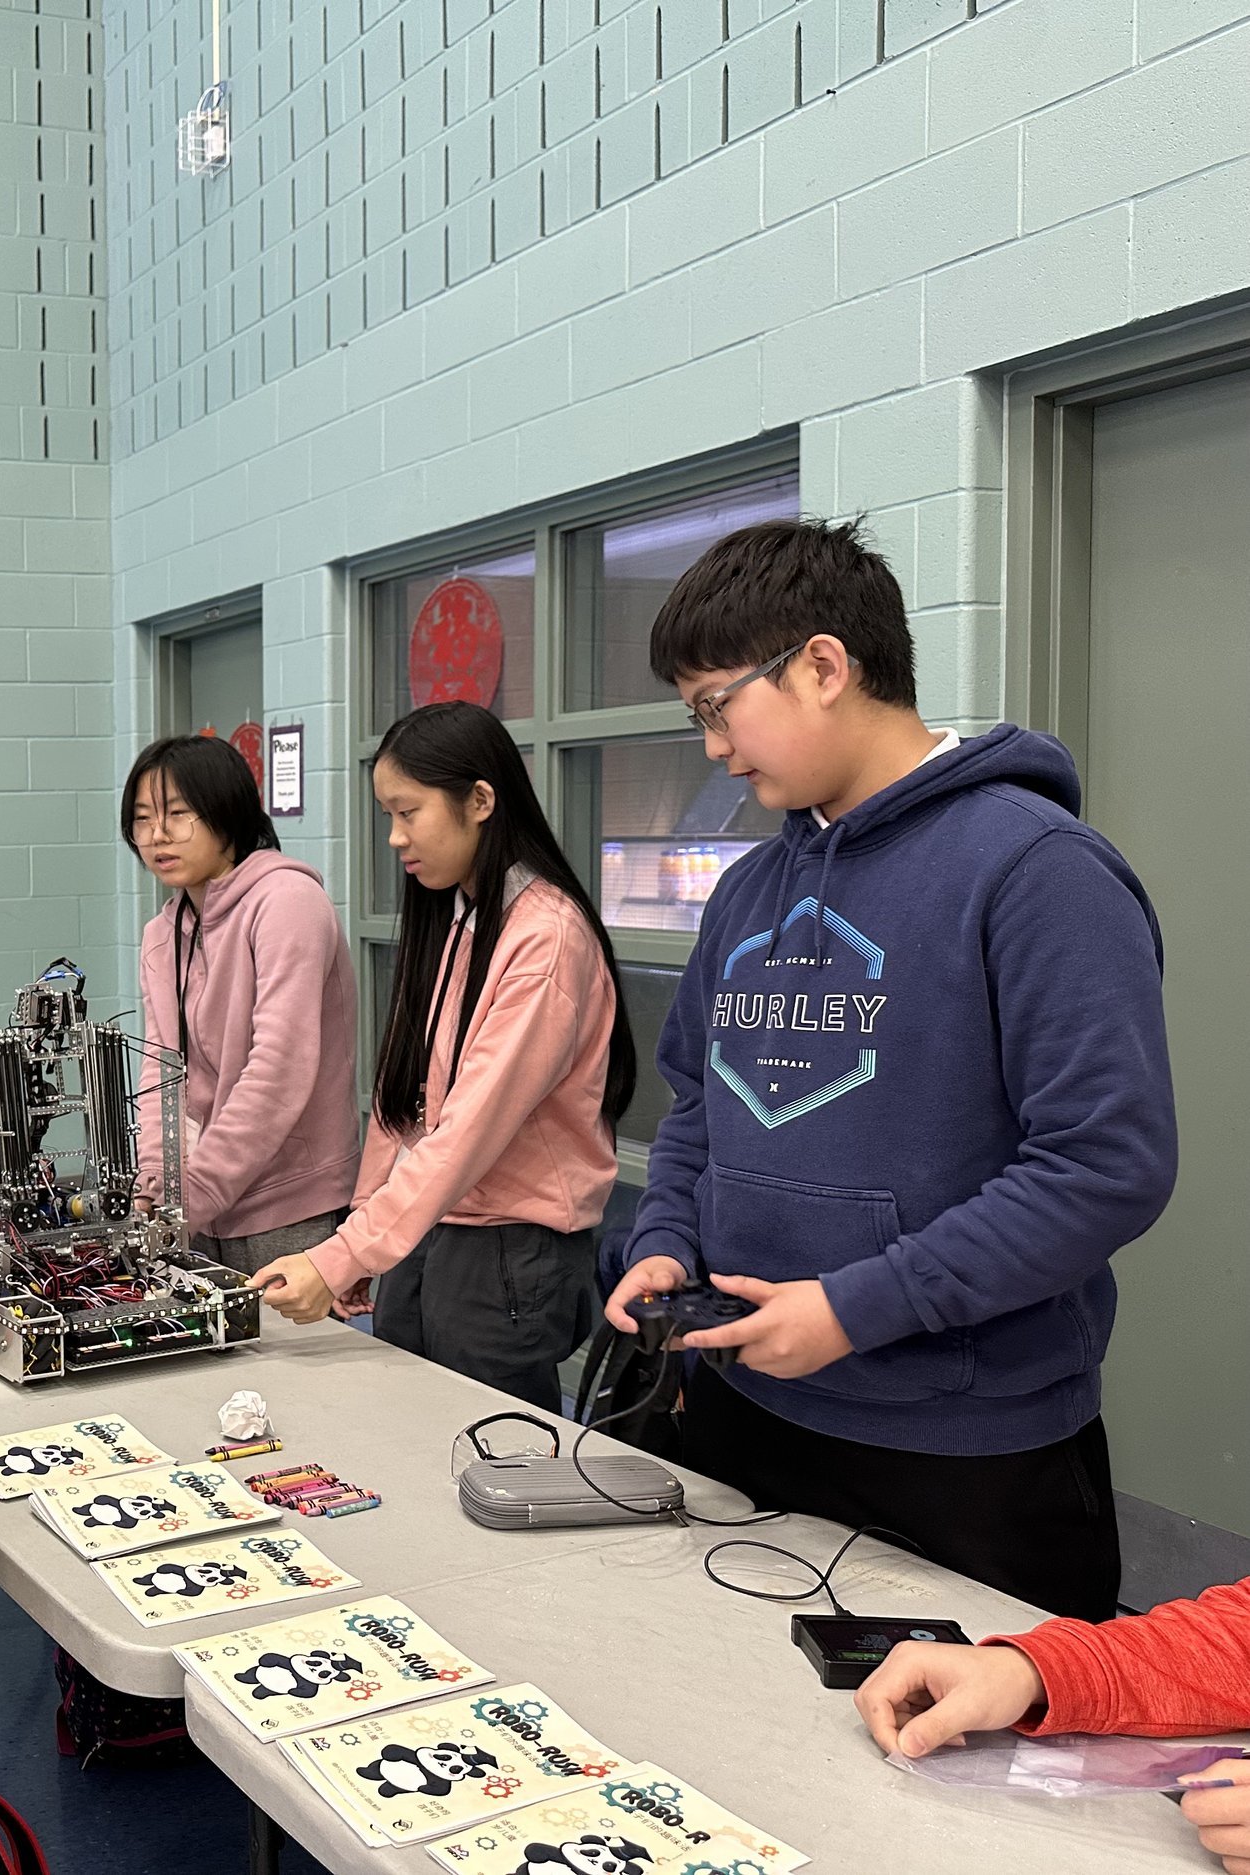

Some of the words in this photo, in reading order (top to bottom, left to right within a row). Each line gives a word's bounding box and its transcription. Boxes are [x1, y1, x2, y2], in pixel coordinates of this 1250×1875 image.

[273, 739, 299, 754] Please
[765, 959, 783, 967] EST.
[786, 957, 833, 965] MCMXIX
[712, 993, 887, 1033] HURLEY
[757, 1058, 811, 1069] TRADEMARK
[85, 1424, 139, 1464] ROBO-RUSH
[181, 1475, 238, 1519] ROBO-RUSH
[254, 1541, 314, 1586] ROBO-RUSH
[360, 1620, 441, 1680] ROBO-RUSH
[489, 1705, 584, 1777] ROBO-RUSH
